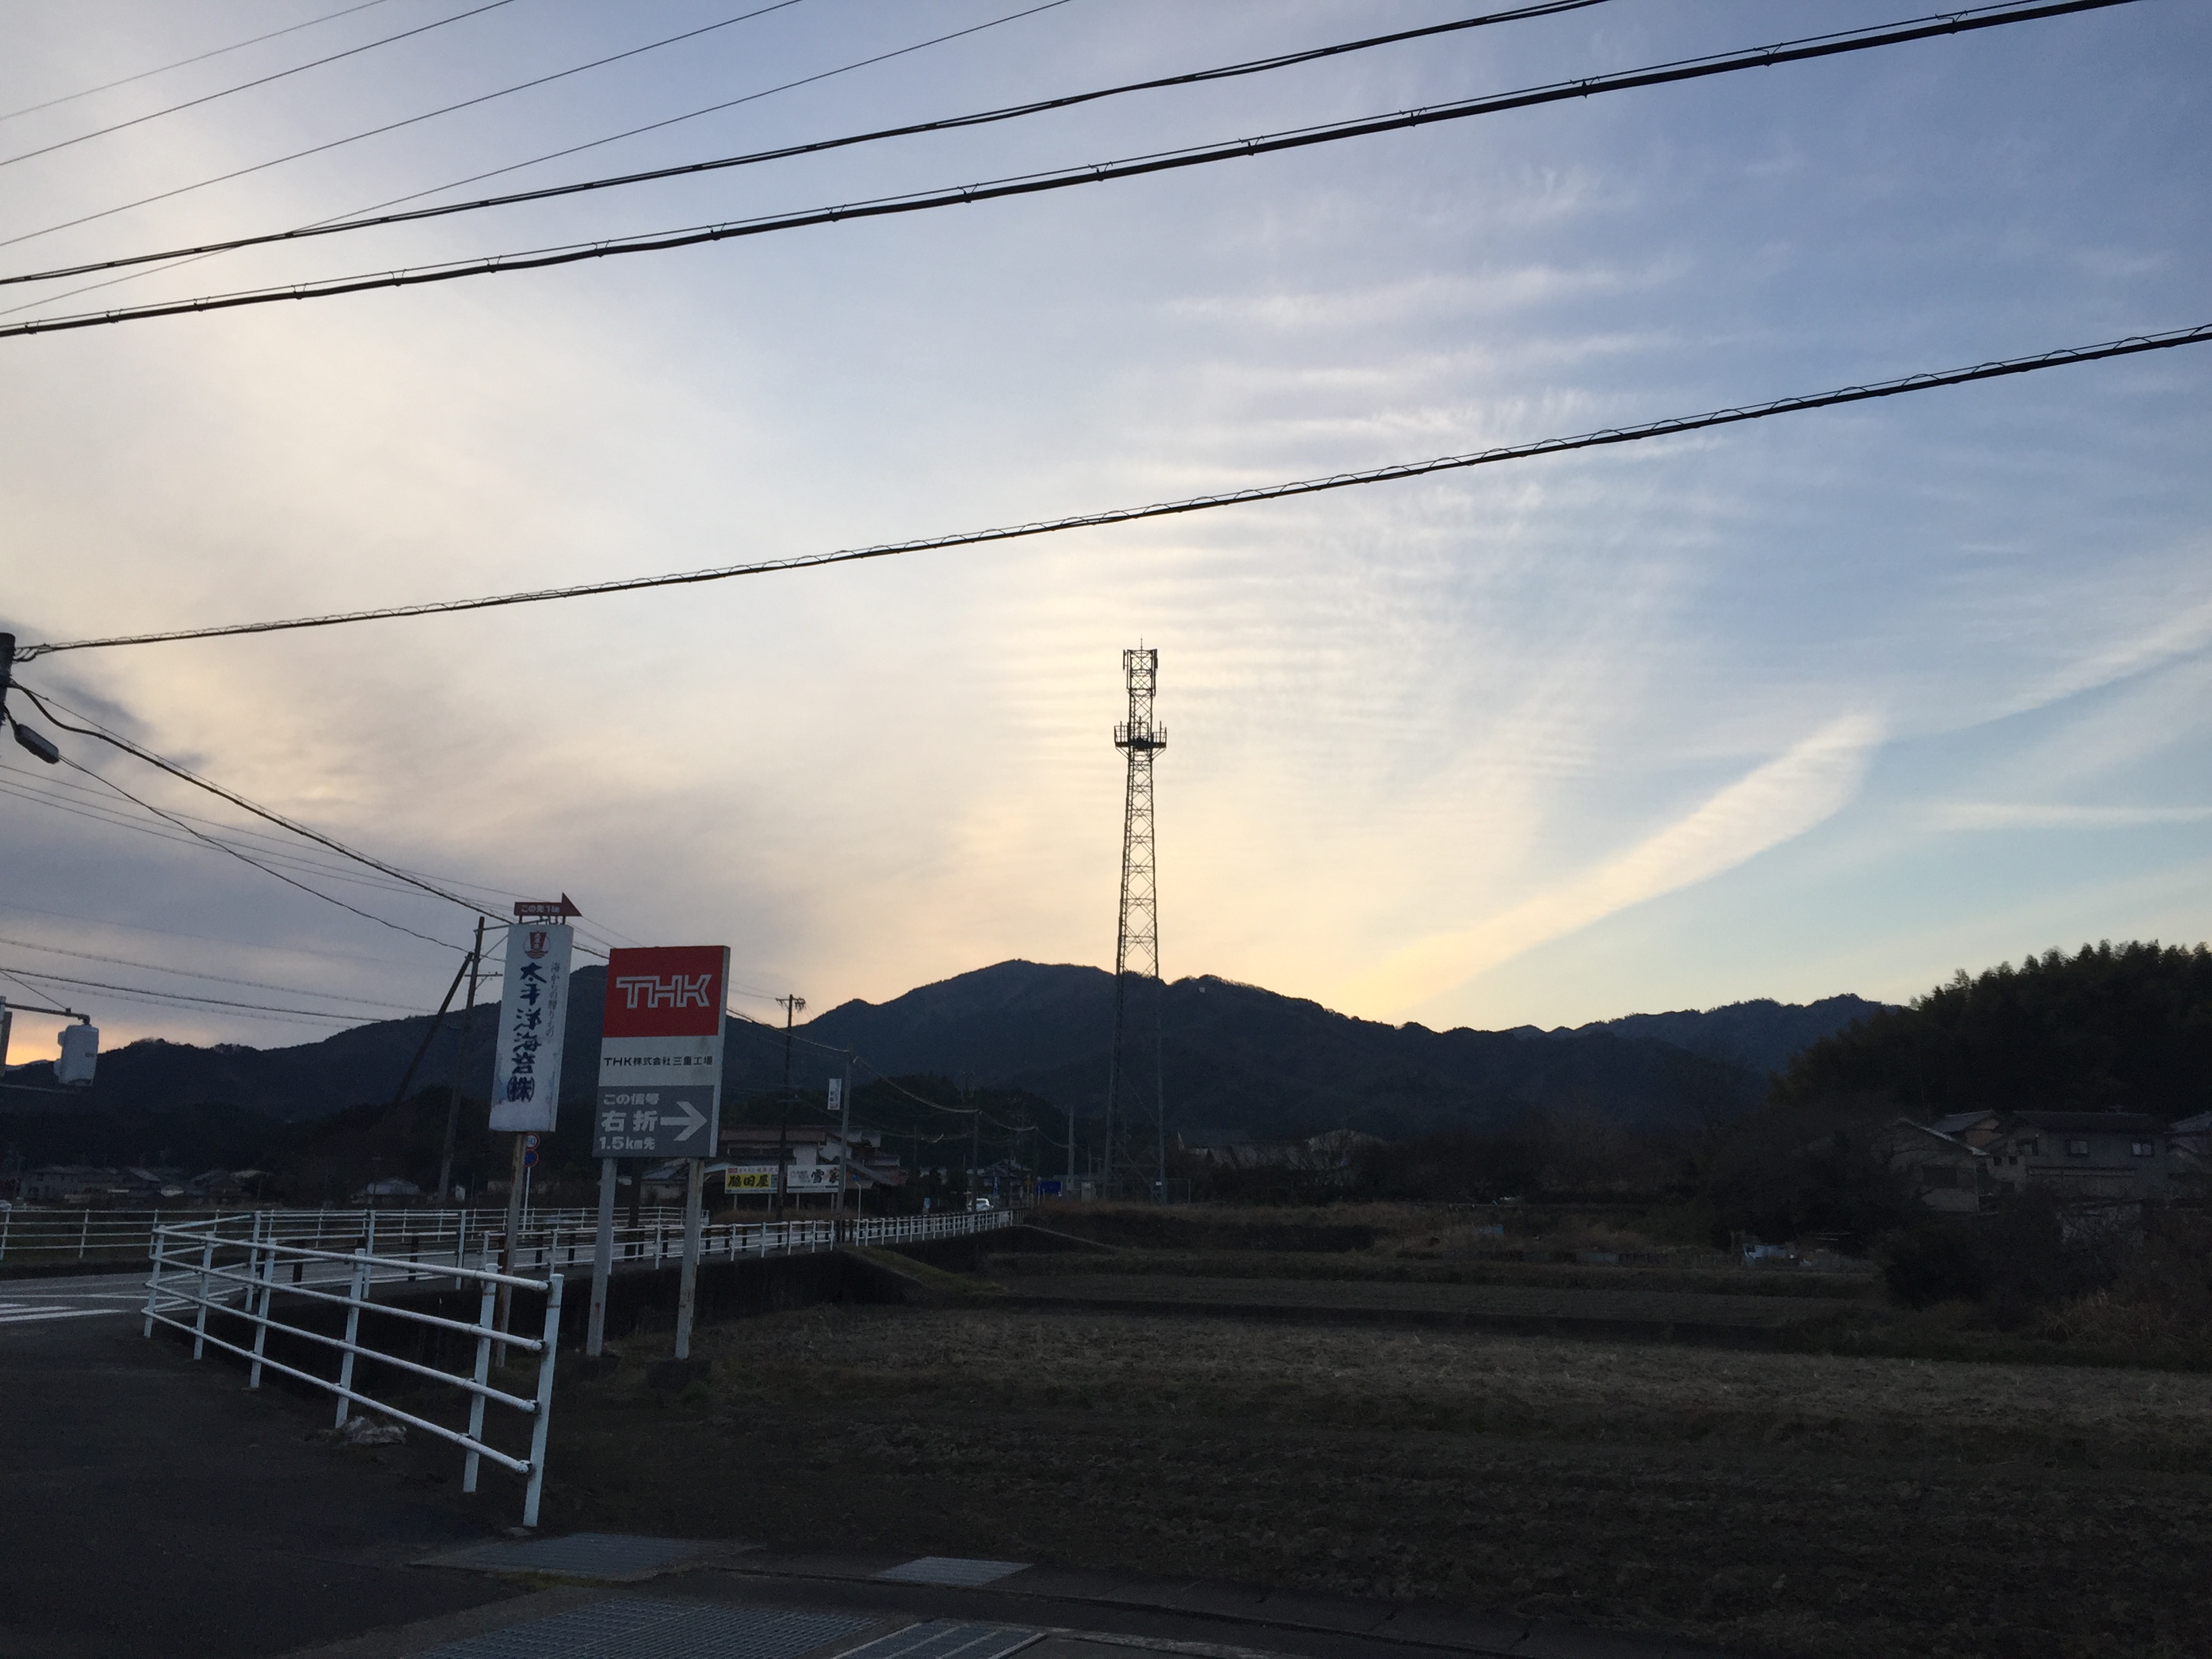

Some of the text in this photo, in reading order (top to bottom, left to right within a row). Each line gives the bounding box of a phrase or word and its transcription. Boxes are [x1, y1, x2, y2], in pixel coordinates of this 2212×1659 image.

[616, 975, 712, 1008] THK
[603, 1092, 659, 1105] この信号
[599, 1134, 656, 1150] 1.5km先
